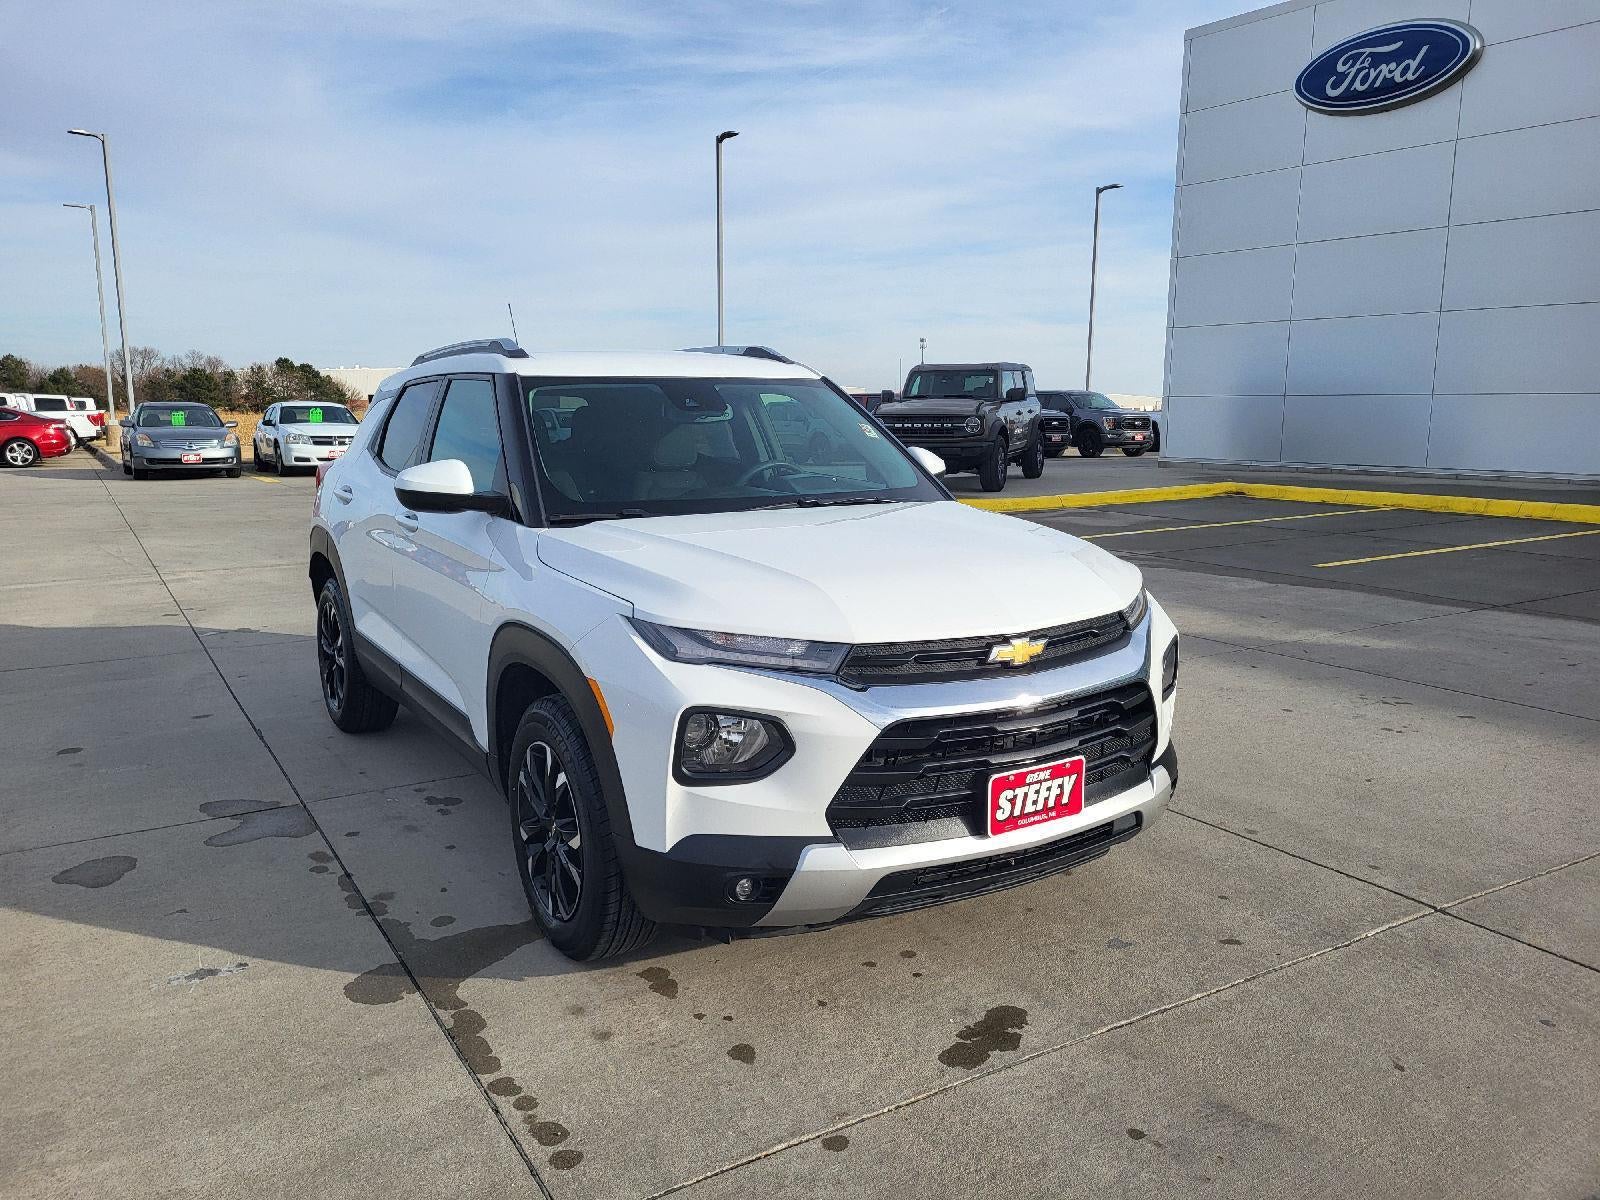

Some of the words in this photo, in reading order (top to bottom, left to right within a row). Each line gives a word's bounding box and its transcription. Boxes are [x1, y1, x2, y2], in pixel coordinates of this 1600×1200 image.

[1325, 41, 1431, 97] Ford
[995, 773, 1078, 821] STEFFY
[1026, 769, 1052, 783] GENE
